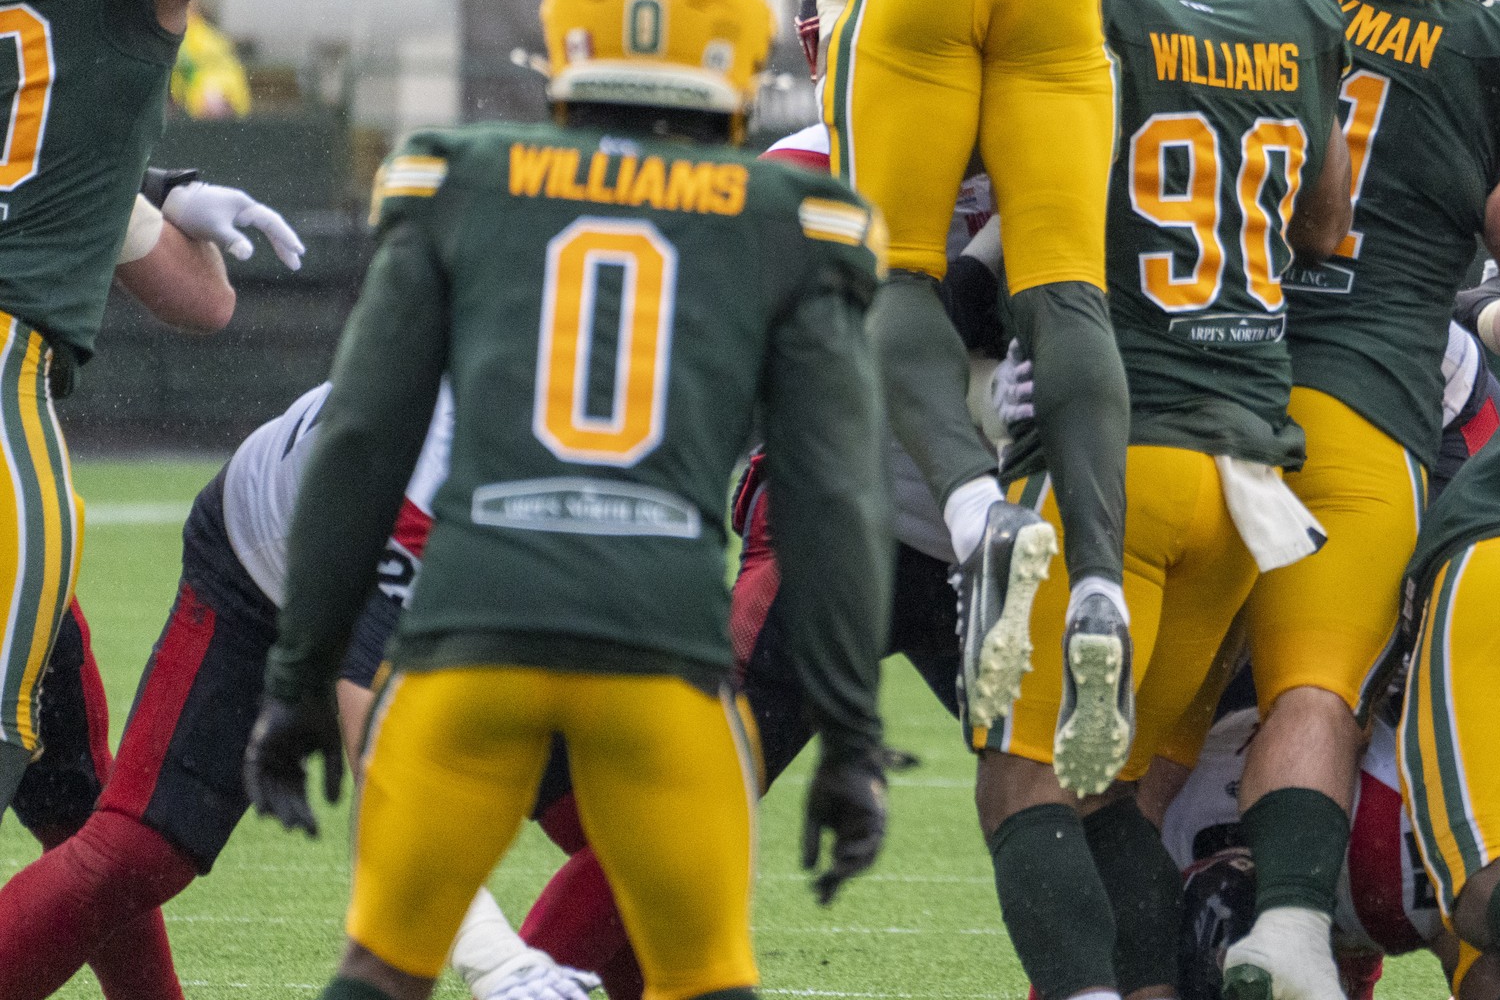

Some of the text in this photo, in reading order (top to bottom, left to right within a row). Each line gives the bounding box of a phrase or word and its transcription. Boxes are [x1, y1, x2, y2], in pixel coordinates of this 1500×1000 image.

[1149, 31, 1299, 92] WILLIAMS
[509, 143, 749, 217] WILLIAMS
[1128, 111, 1308, 313] 90
[532, 214, 680, 470] 0
